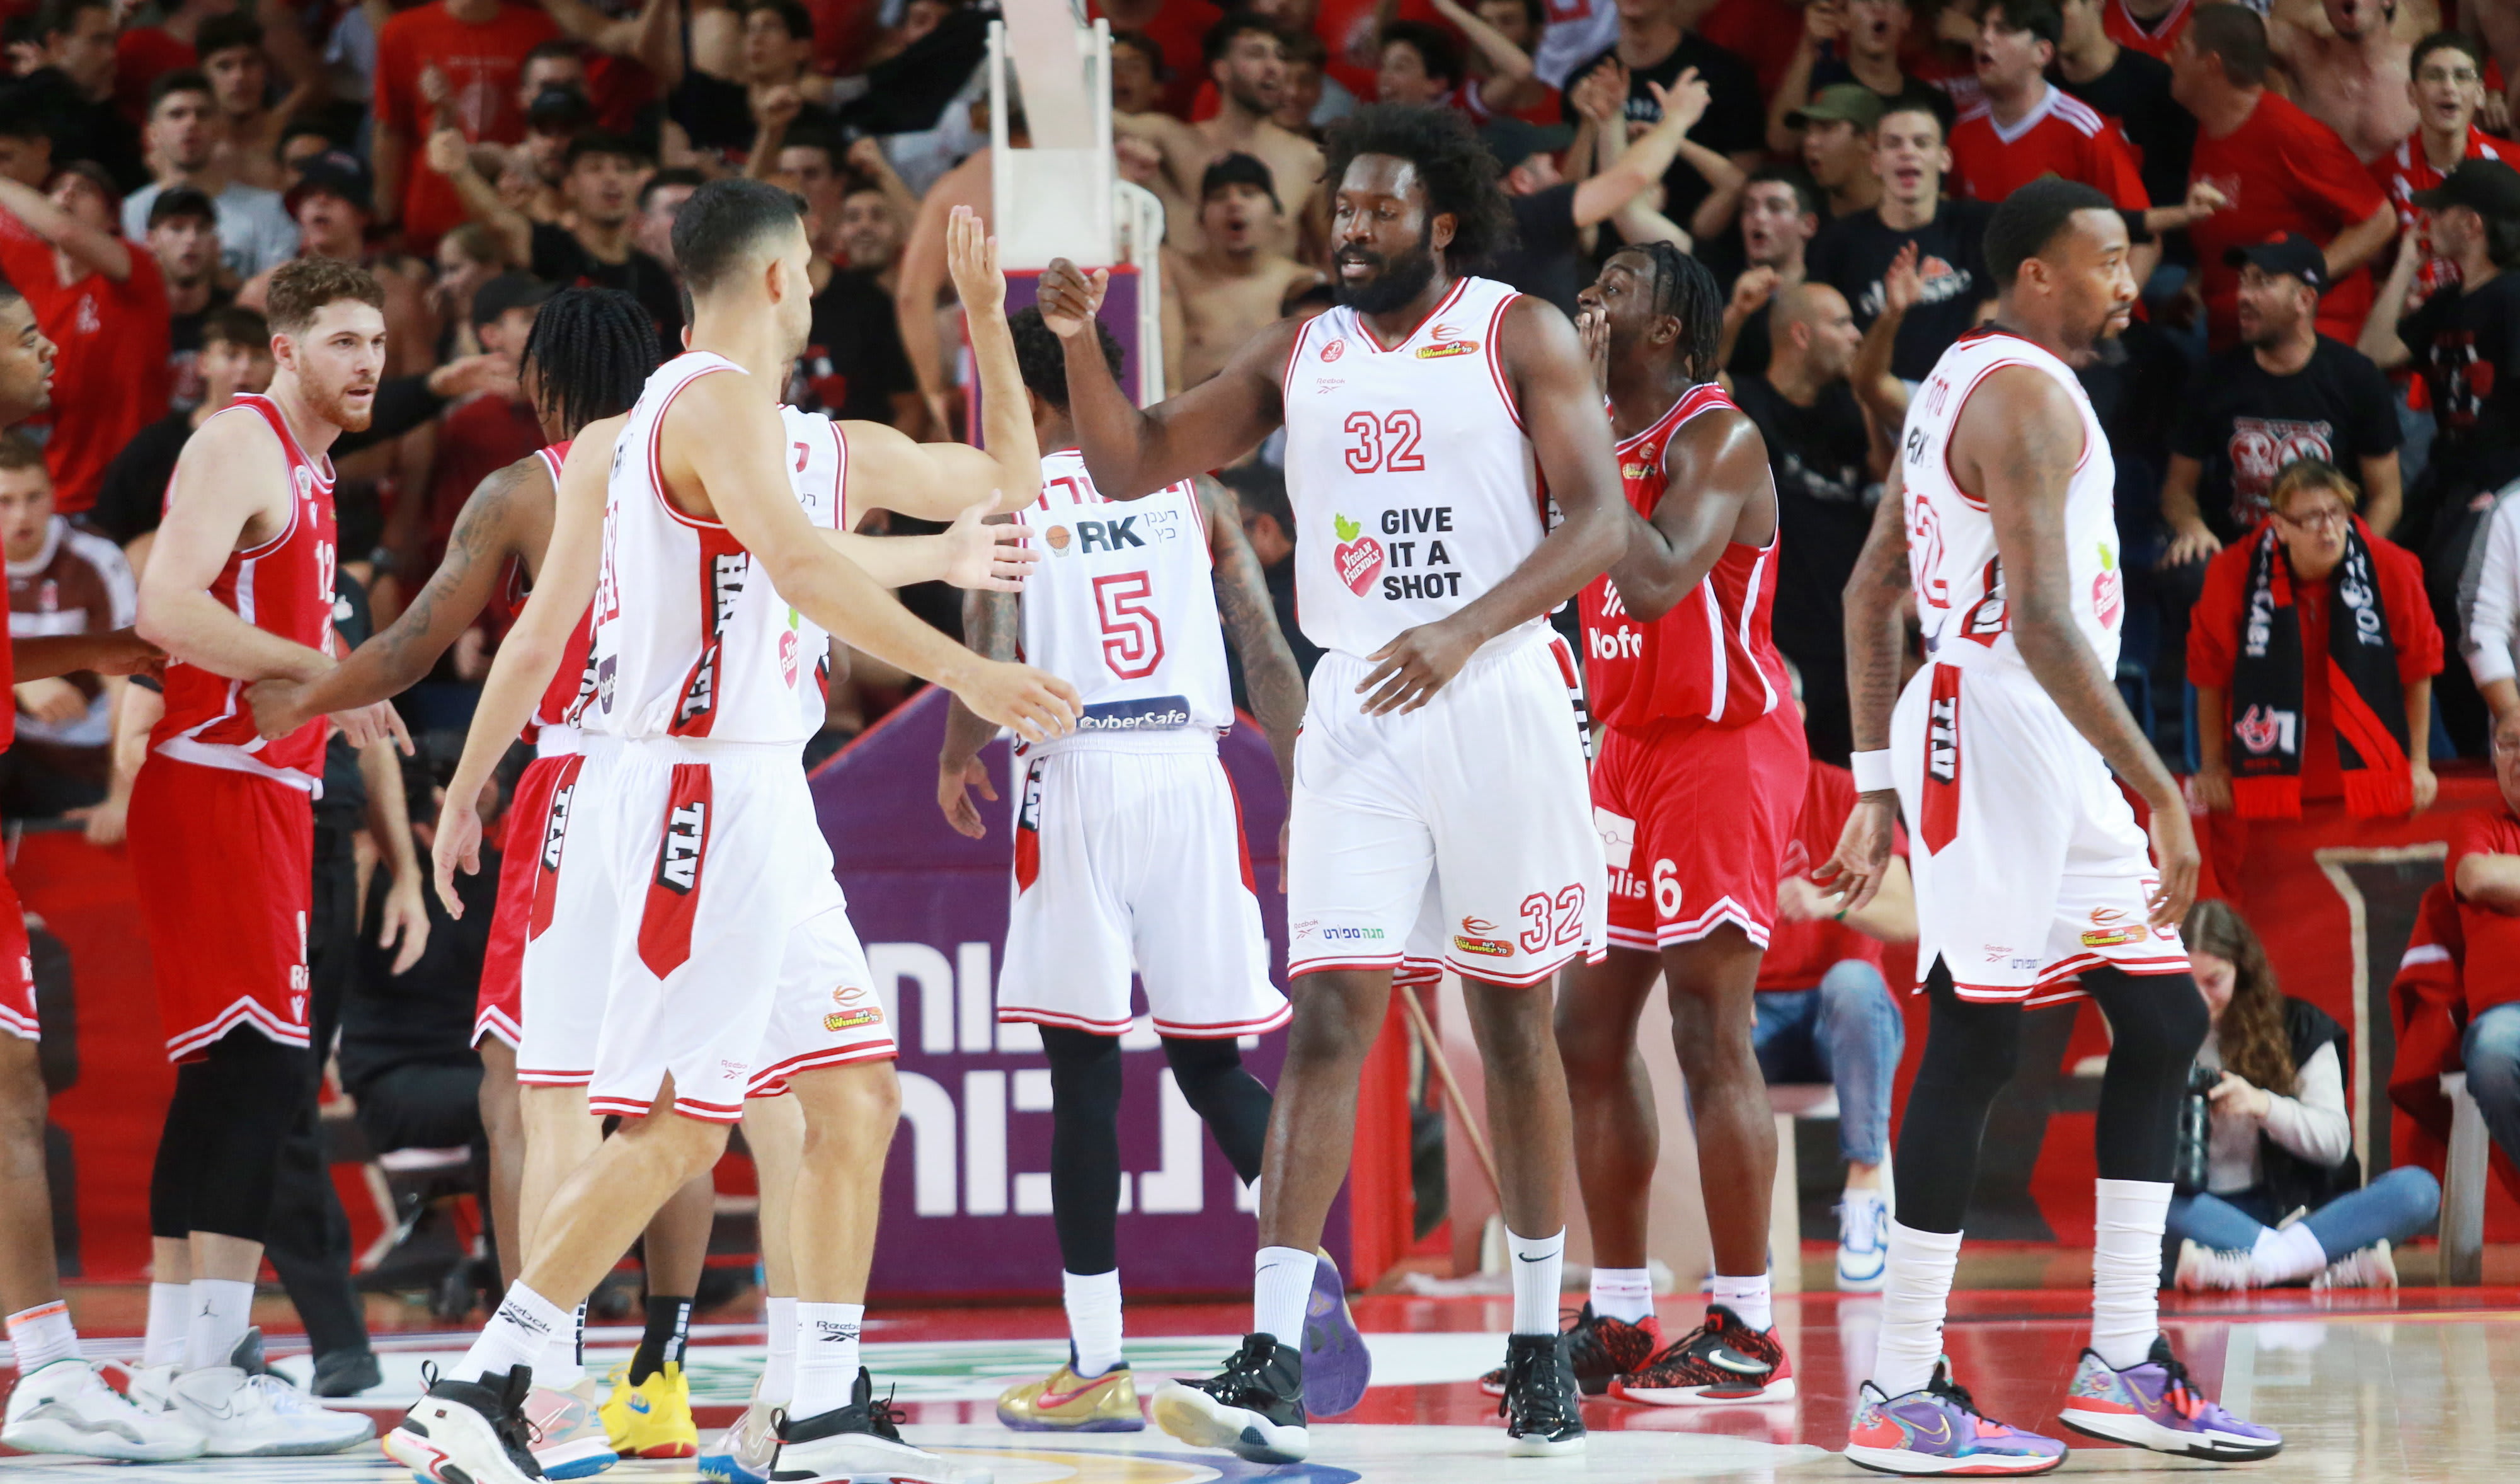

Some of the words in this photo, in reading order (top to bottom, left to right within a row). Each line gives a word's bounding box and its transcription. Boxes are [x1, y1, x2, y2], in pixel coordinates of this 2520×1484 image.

[1422, 348, 1462, 359] Winner
[1344, 409, 1425, 474] 32
[1143, 510, 1178, 527] רענן
[1382, 507, 1453, 534] GIVE
[1076, 515, 1146, 553] RK
[1155, 528, 1176, 543] כץ
[1341, 541, 1373, 569] VEGAN
[1390, 542, 1416, 567] IT
[1427, 540, 1451, 566] A
[315, 539, 336, 604] 12
[1343, 549, 1381, 587] FRIENDLY
[1383, 572, 1462, 601] SHOT
[1092, 570, 1166, 680] 5
[660, 802, 706, 892] TLV
[1652, 858, 1683, 919] 6
[1294, 919, 1319, 929] Reebok
[1520, 882, 1586, 955] 32
[1324, 925, 1361, 940] ספורט
[1361, 928, 1385, 939] מגה
[1458, 939, 1497, 953] Winner
[830, 1016, 871, 1029] Winner
